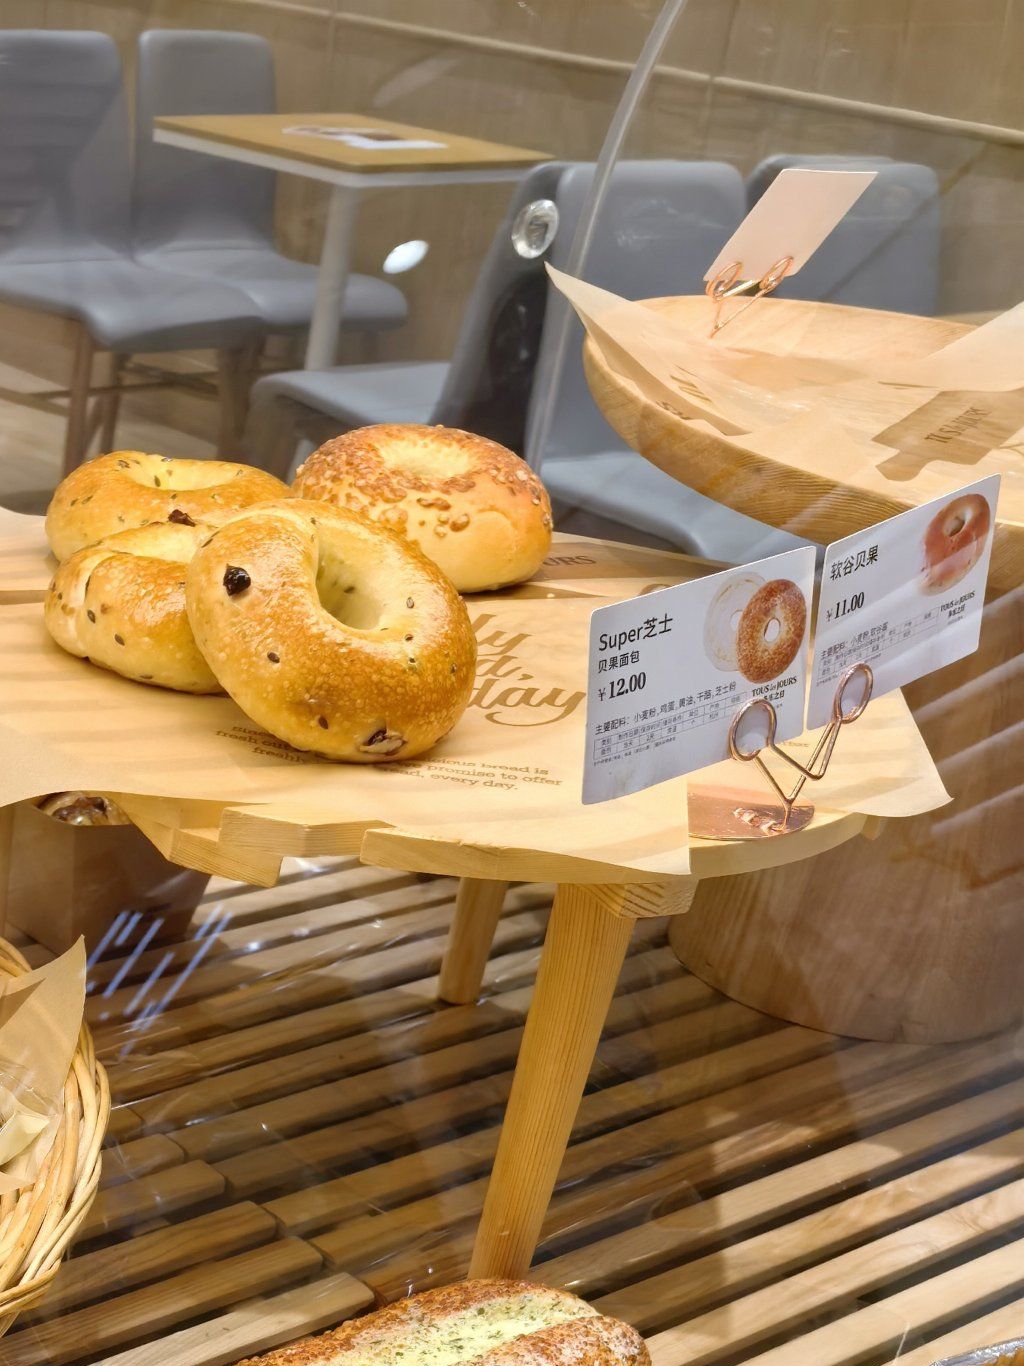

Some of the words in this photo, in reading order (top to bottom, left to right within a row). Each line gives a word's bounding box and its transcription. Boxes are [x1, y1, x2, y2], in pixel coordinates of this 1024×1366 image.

[829, 545, 879, 581] 软谷贝果
[598, 613, 673, 651] Super芝士
[598, 650, 640, 674] 贝果面包
[598, 671, 647, 702] ¥12.00
[426, 765, 495, 778] promise
[499, 772, 518, 781] to
[521, 776, 564, 787] offer
[430, 774, 479, 786] every
